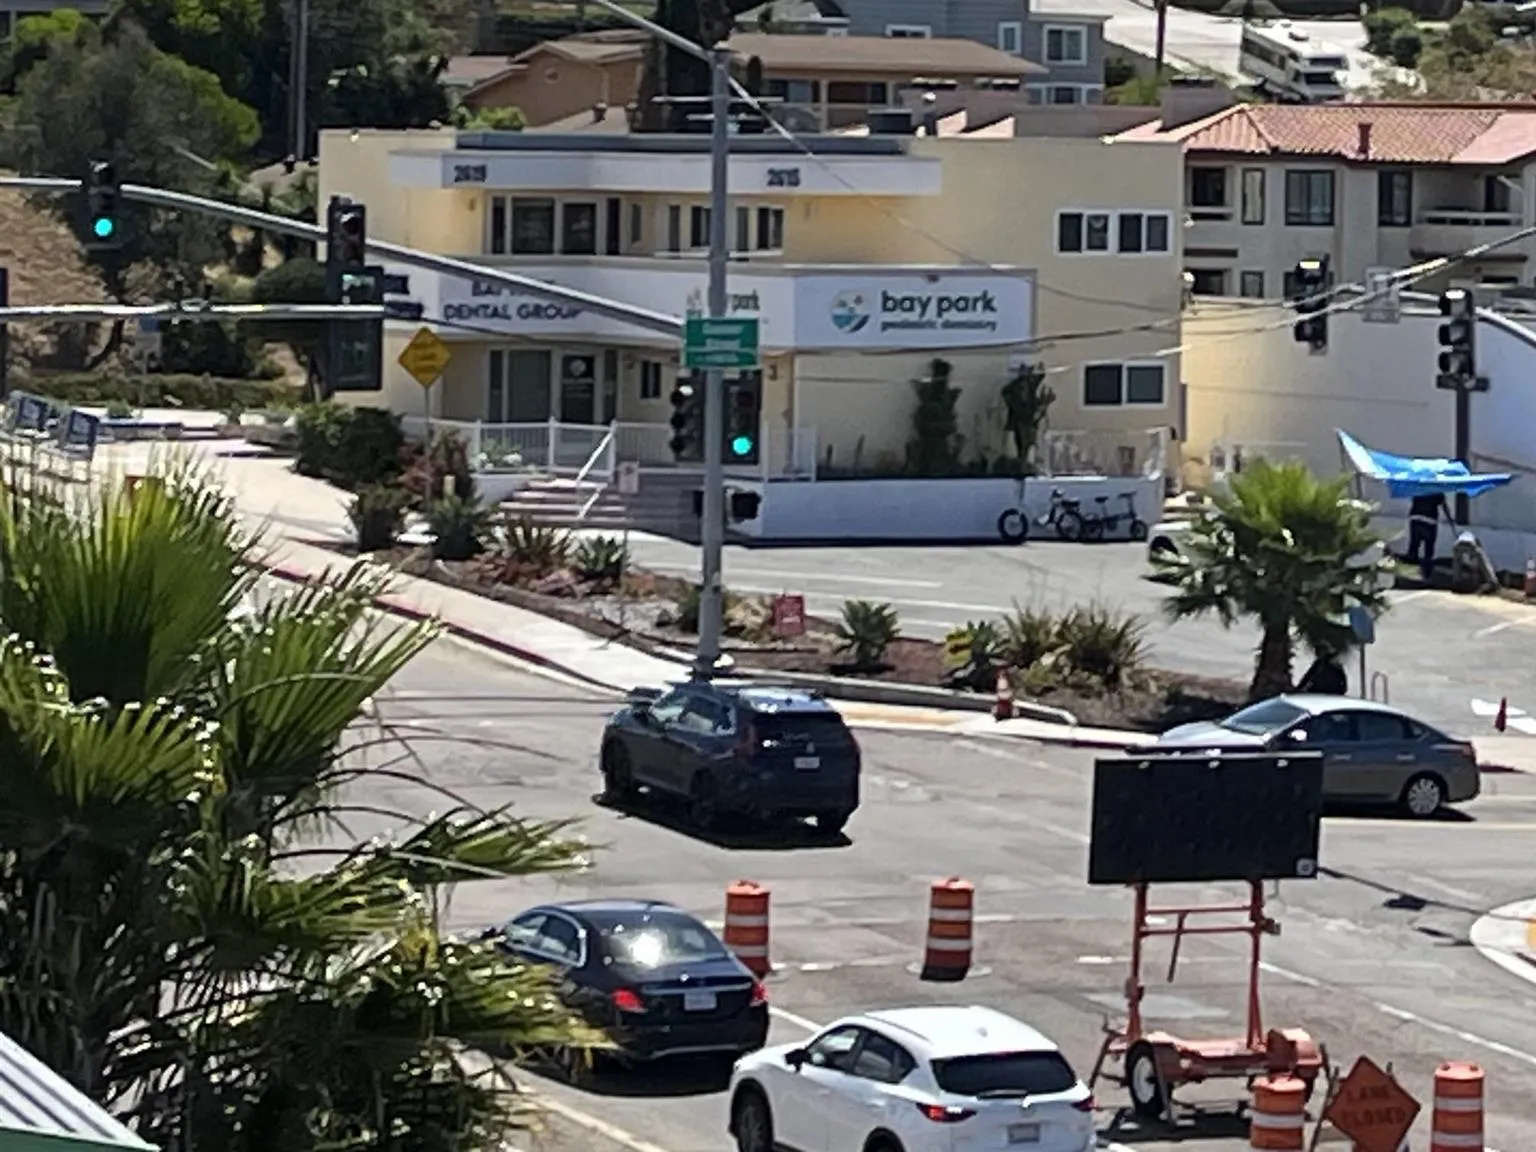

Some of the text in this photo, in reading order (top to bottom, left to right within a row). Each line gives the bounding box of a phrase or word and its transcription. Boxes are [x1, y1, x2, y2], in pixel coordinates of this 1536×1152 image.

[443, 302, 512, 321] DENTAL
[881, 289, 997, 319] bay park
